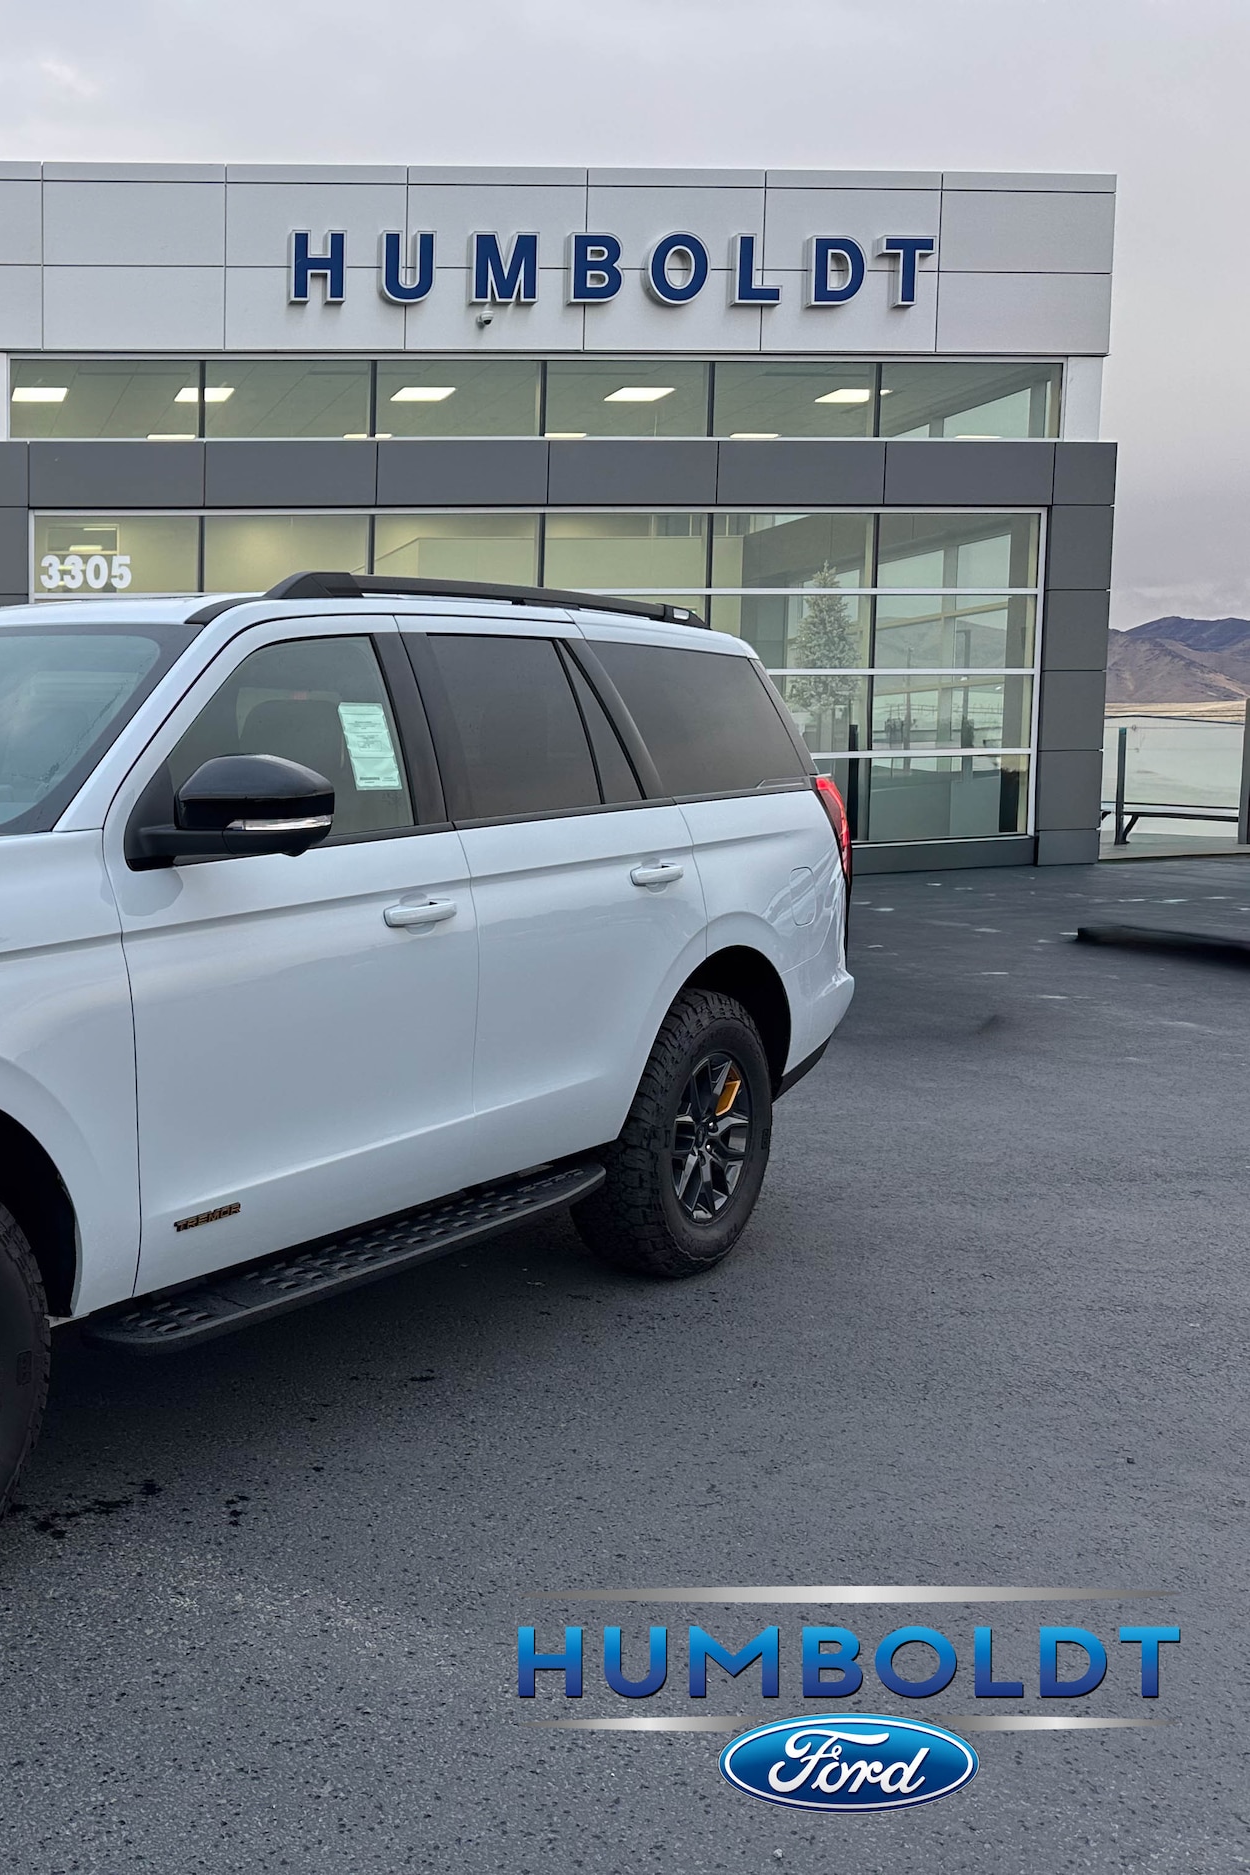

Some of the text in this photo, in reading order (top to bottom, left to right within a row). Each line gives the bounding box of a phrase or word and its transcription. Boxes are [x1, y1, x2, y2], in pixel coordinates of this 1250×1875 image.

[287, 229, 935, 307] HUMBOLDT
[40, 555, 132, 589] 3305
[173, 1202, 241, 1232] TREMOR
